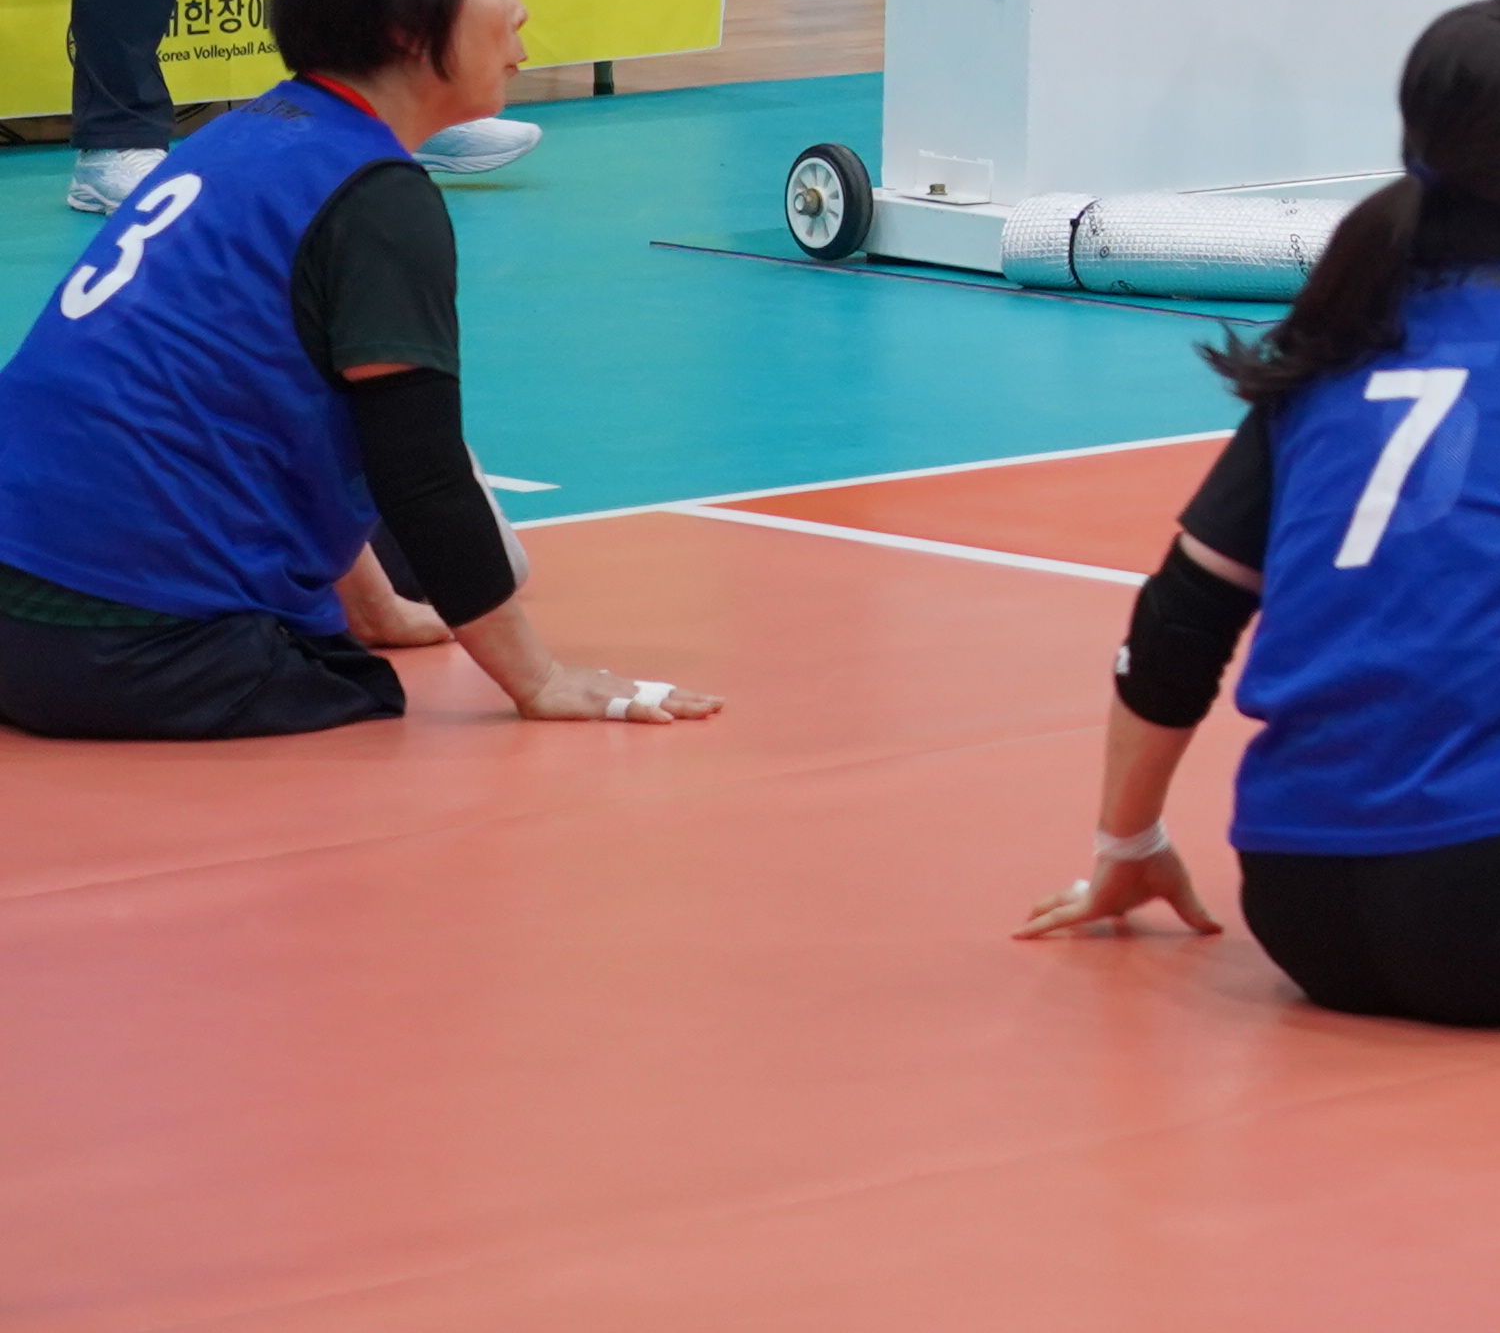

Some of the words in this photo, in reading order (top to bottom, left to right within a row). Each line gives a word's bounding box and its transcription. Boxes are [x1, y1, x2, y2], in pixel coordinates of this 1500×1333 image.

[194, 40, 254, 64] Volleyball
[60, 172, 203, 320] 3
[1333, 367, 1470, 570] 7
